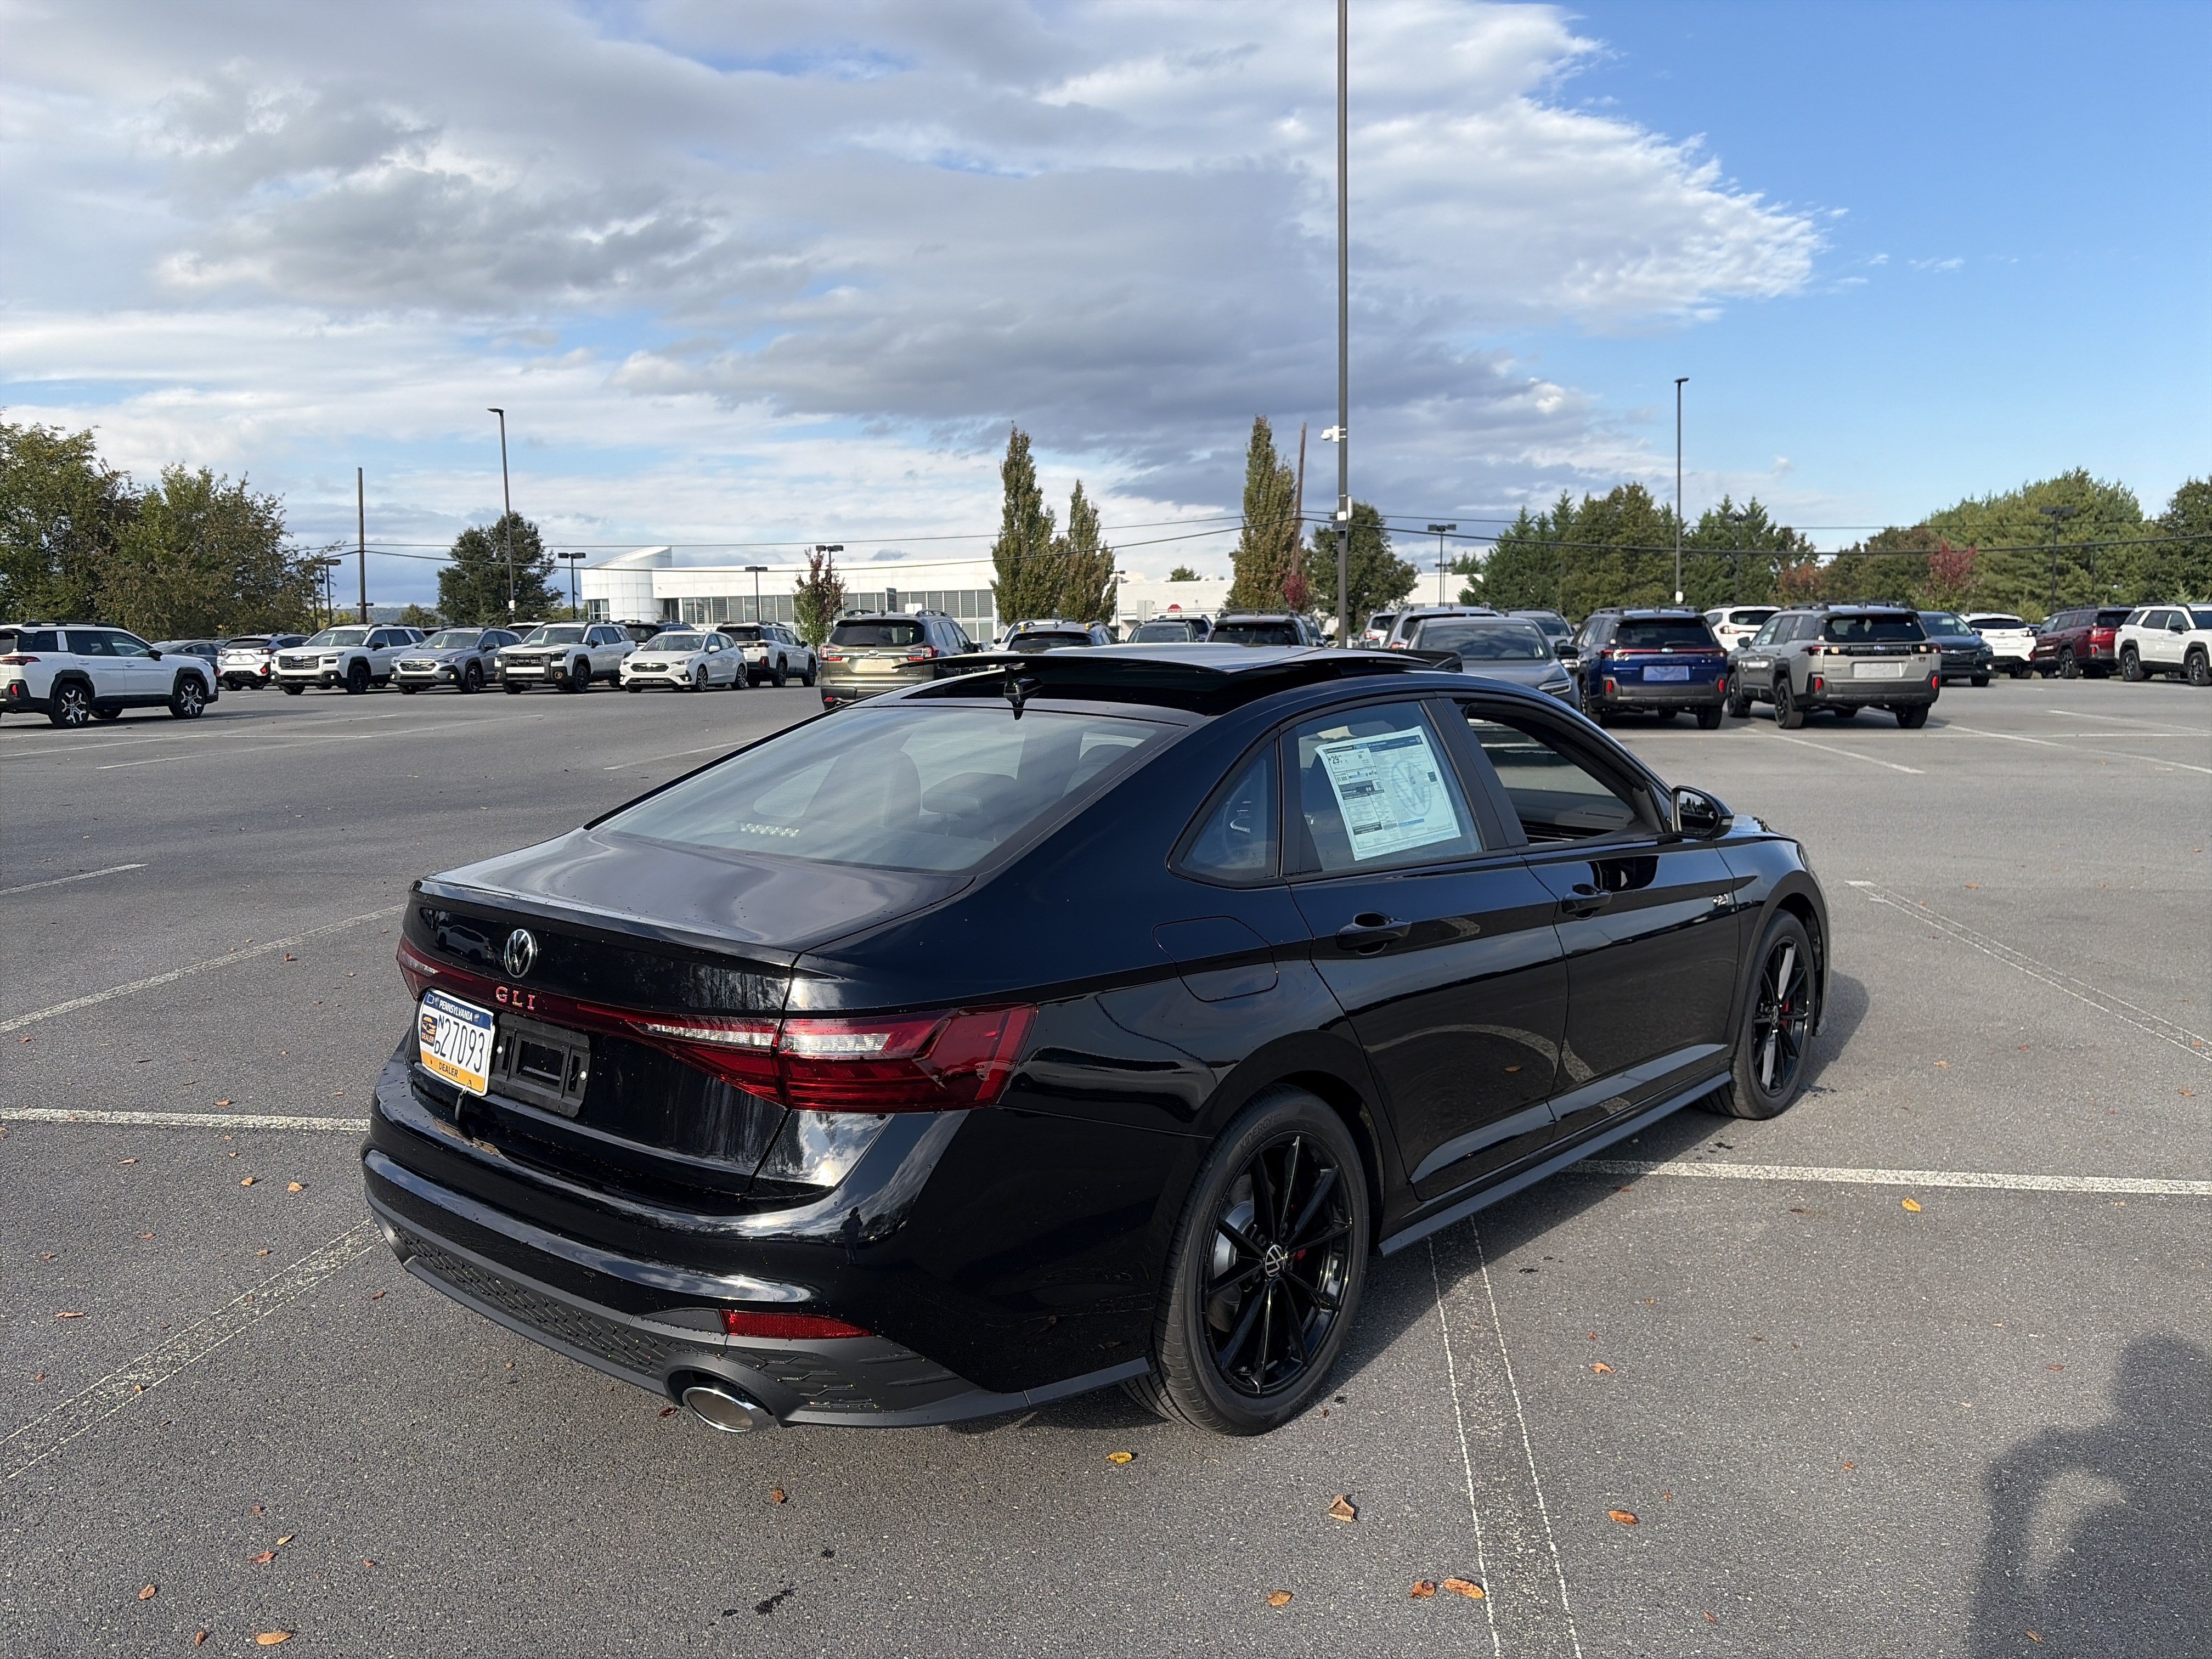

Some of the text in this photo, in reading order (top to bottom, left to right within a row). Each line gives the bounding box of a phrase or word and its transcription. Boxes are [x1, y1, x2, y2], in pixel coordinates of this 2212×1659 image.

[496, 986, 535, 1010] GLI
[438, 1000, 473, 1022] PENNSYLVANIA
[421, 1033, 435, 1044] DEALER
[439, 1062, 458, 1078] DEALER
